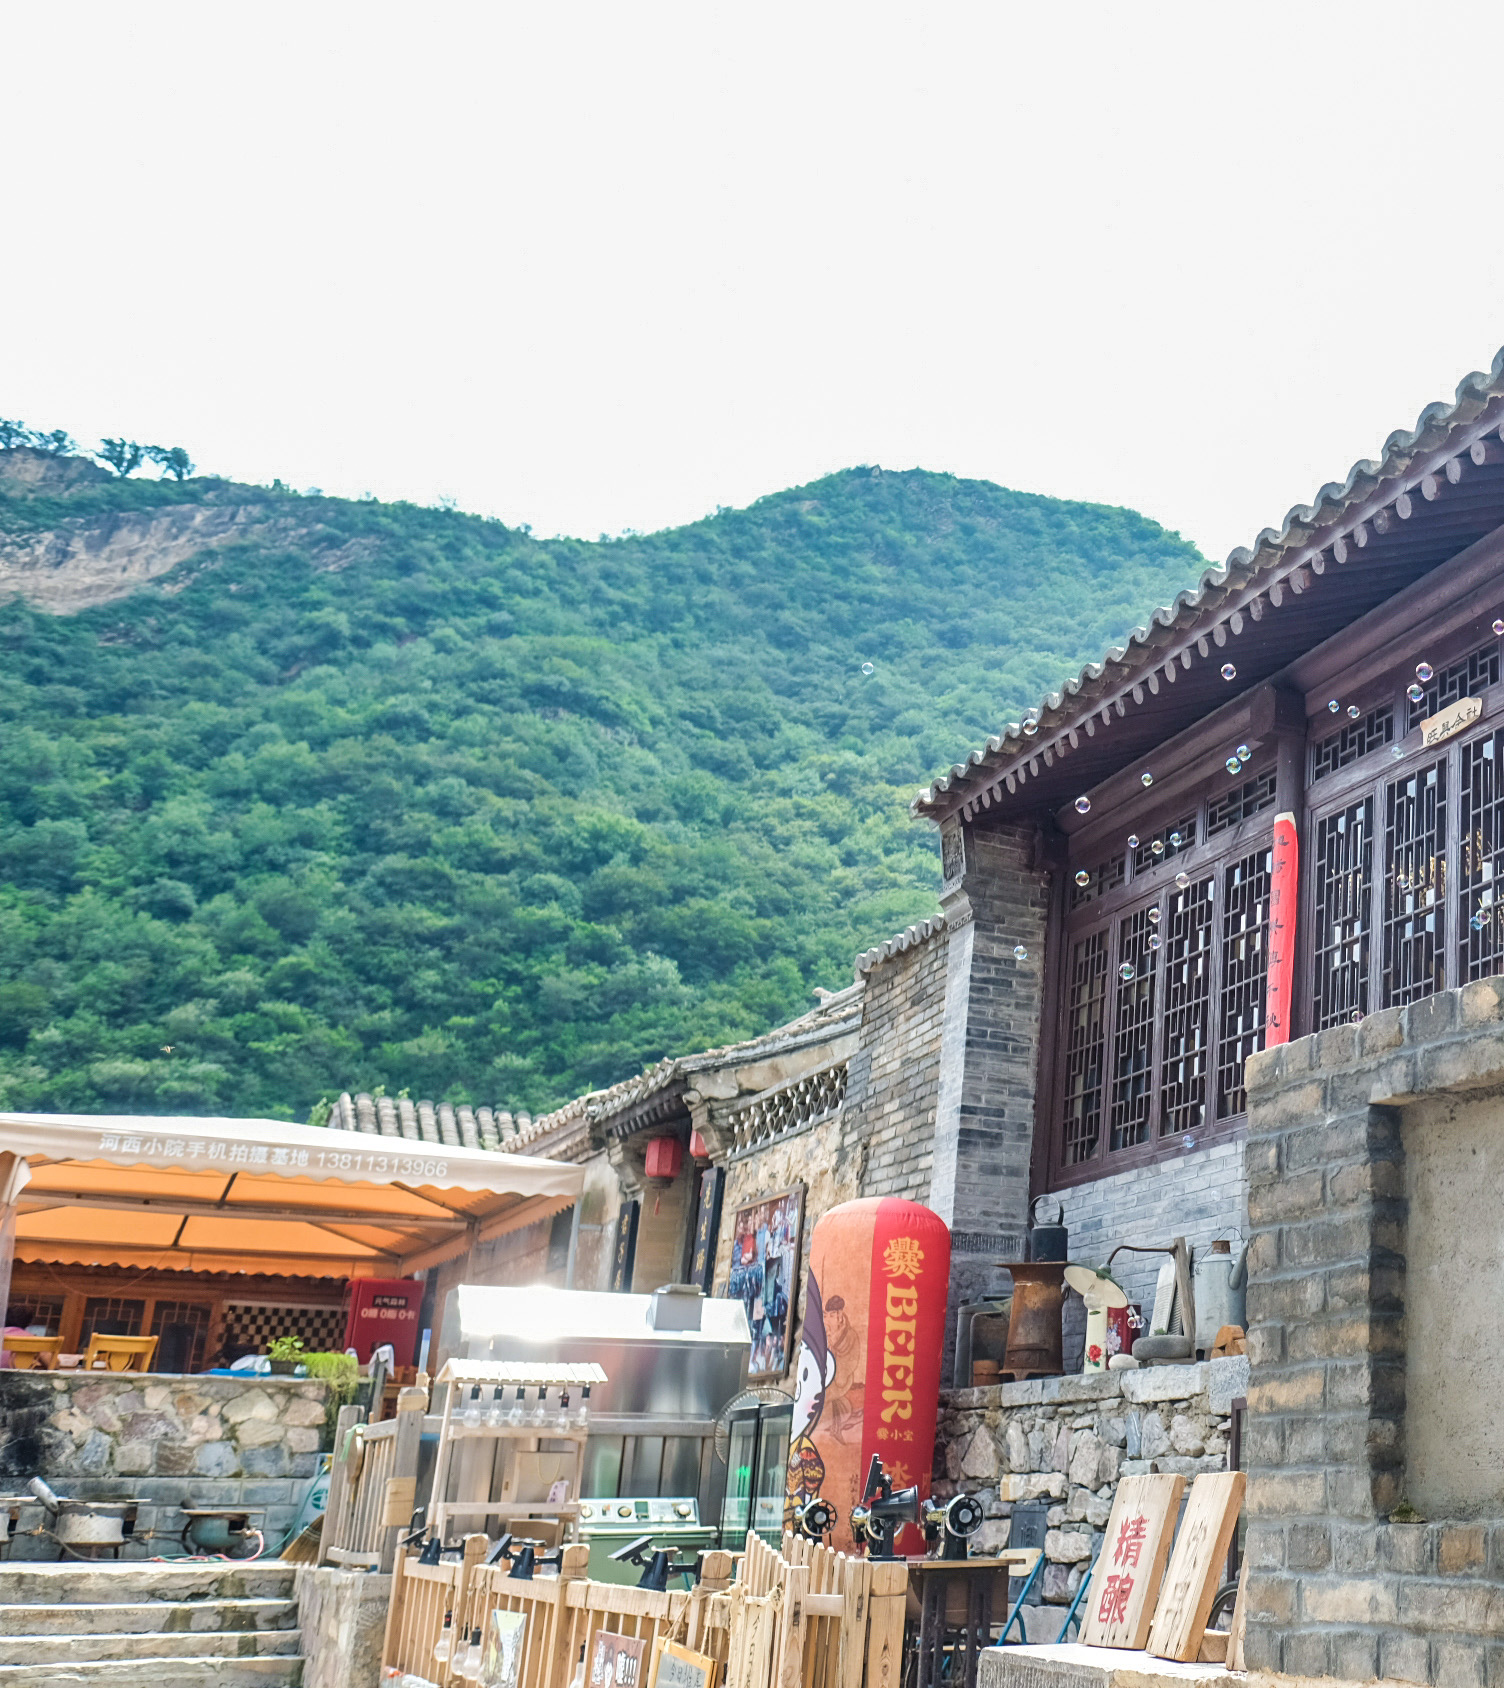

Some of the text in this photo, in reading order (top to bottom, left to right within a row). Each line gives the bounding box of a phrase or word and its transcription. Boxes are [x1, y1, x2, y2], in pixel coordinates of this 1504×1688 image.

[99, 1132, 448, 1178] 河西小院手机拍摄基地 13811313966
[880, 1282, 918, 1423] BEER
[1097, 1514, 1151, 1625] 精酿
